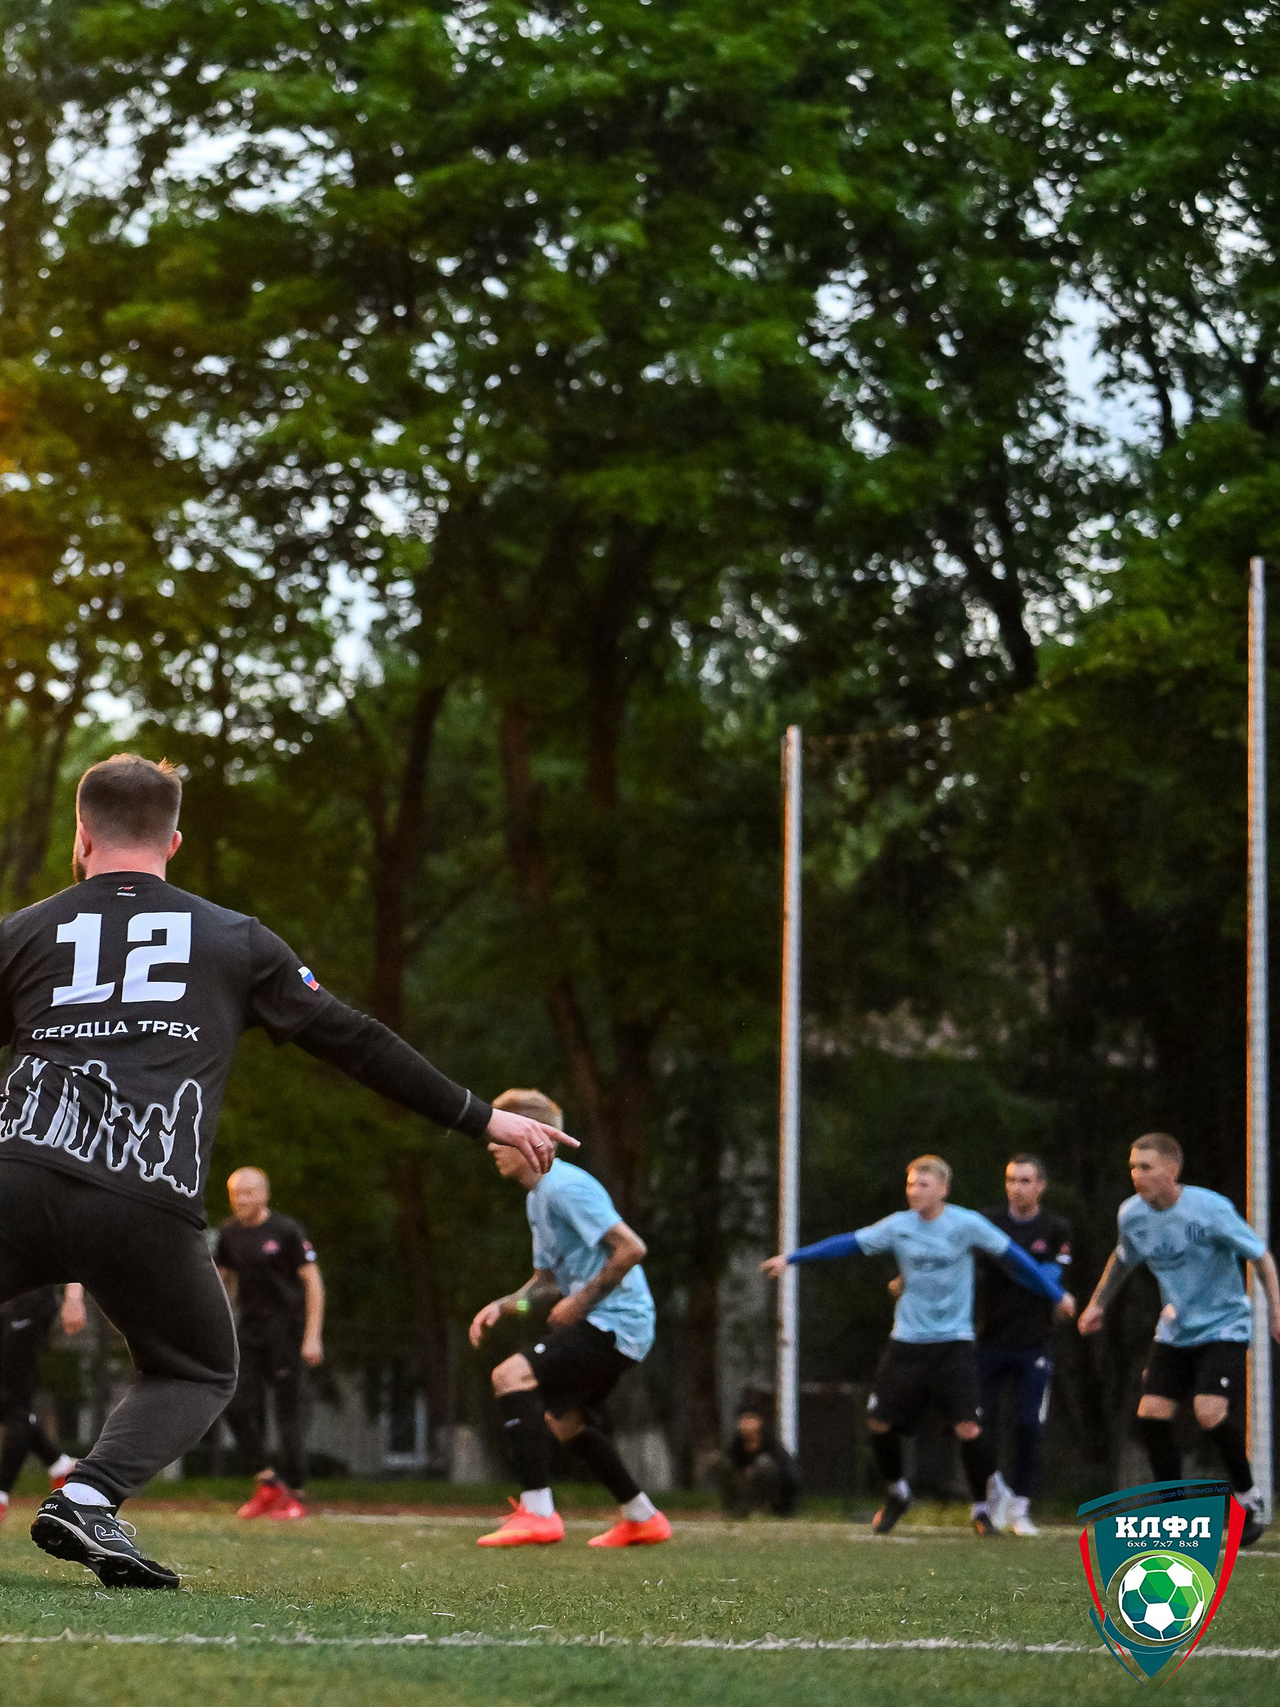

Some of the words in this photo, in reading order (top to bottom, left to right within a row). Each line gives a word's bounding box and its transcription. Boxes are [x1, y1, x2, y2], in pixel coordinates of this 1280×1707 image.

[51, 912, 192, 1007] 12
[31, 1020, 129, 1041] СЕРДЦА
[137, 1020, 201, 1042] ТРЕХ
